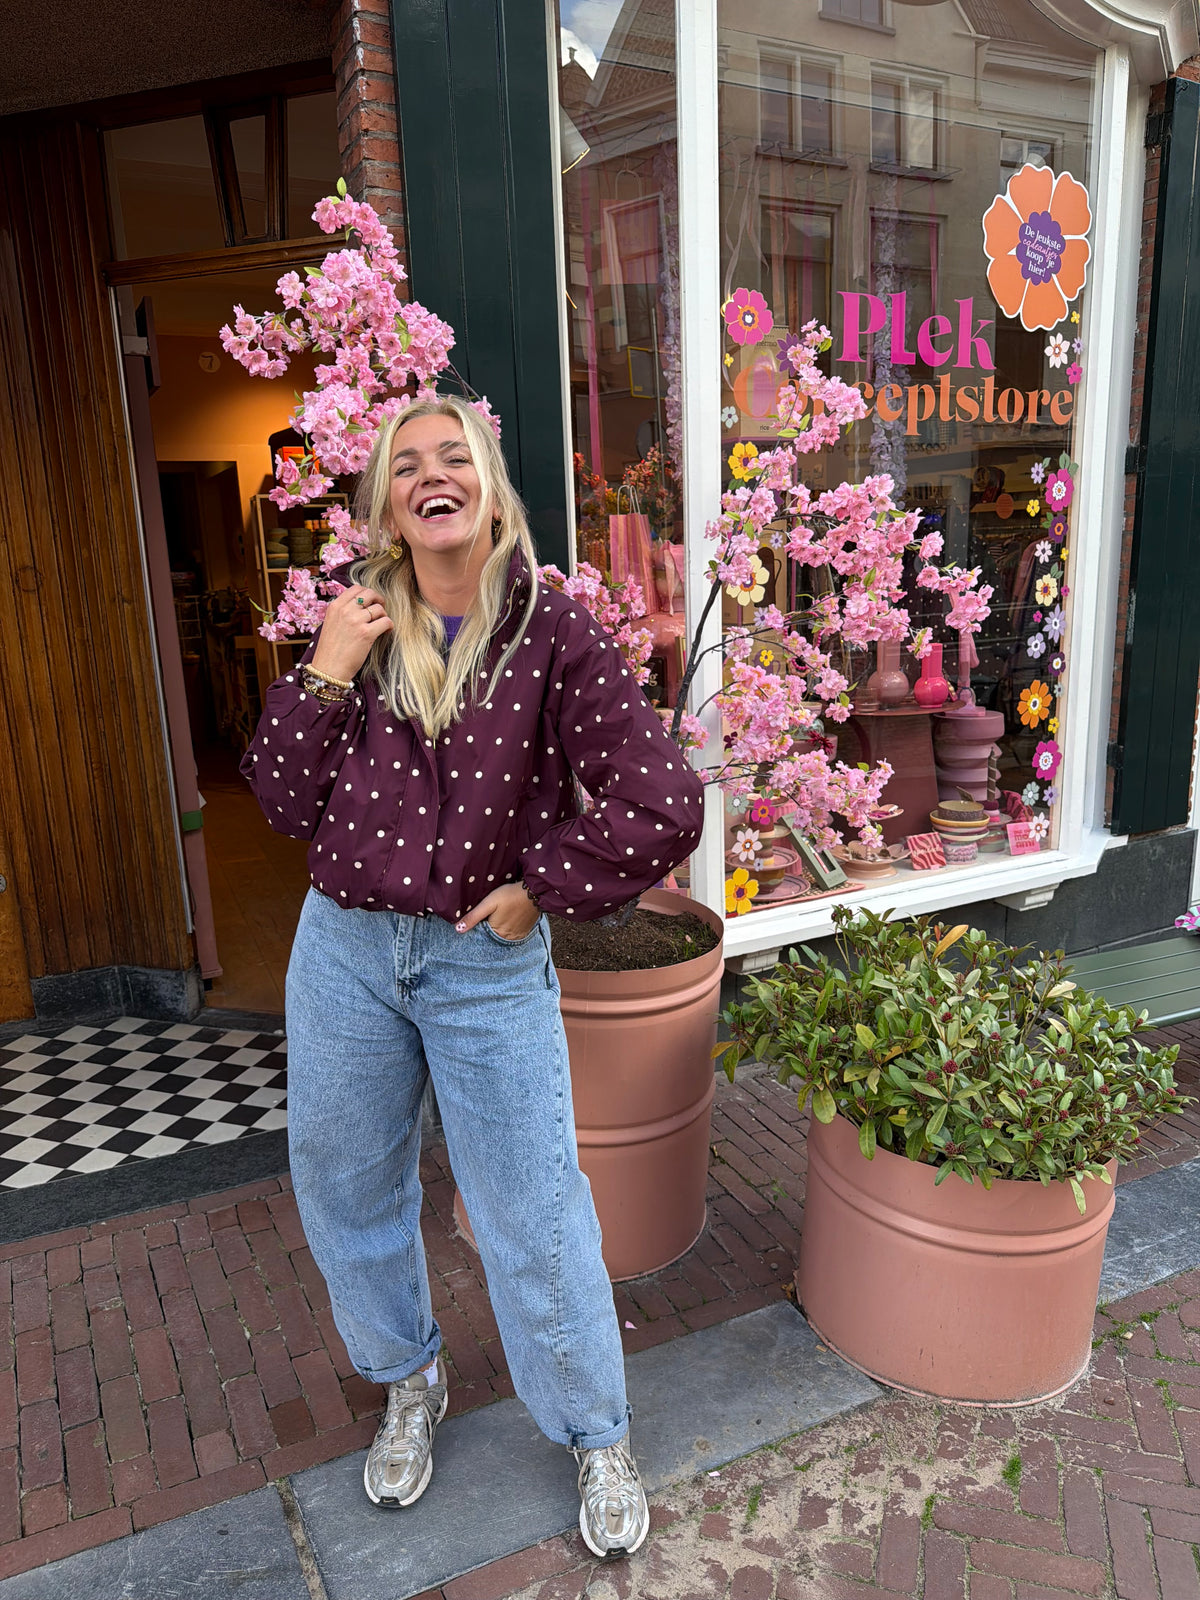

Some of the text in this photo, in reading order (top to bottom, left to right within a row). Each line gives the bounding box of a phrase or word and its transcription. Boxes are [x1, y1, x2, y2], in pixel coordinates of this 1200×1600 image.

[1025, 225, 1061, 250] De leukste
[1023, 239, 1058, 262] cadeautjes
[1026, 245, 1055, 269] koop je
[1028, 261, 1046, 277] hier!
[733, 365, 1074, 436] Coceptstore
